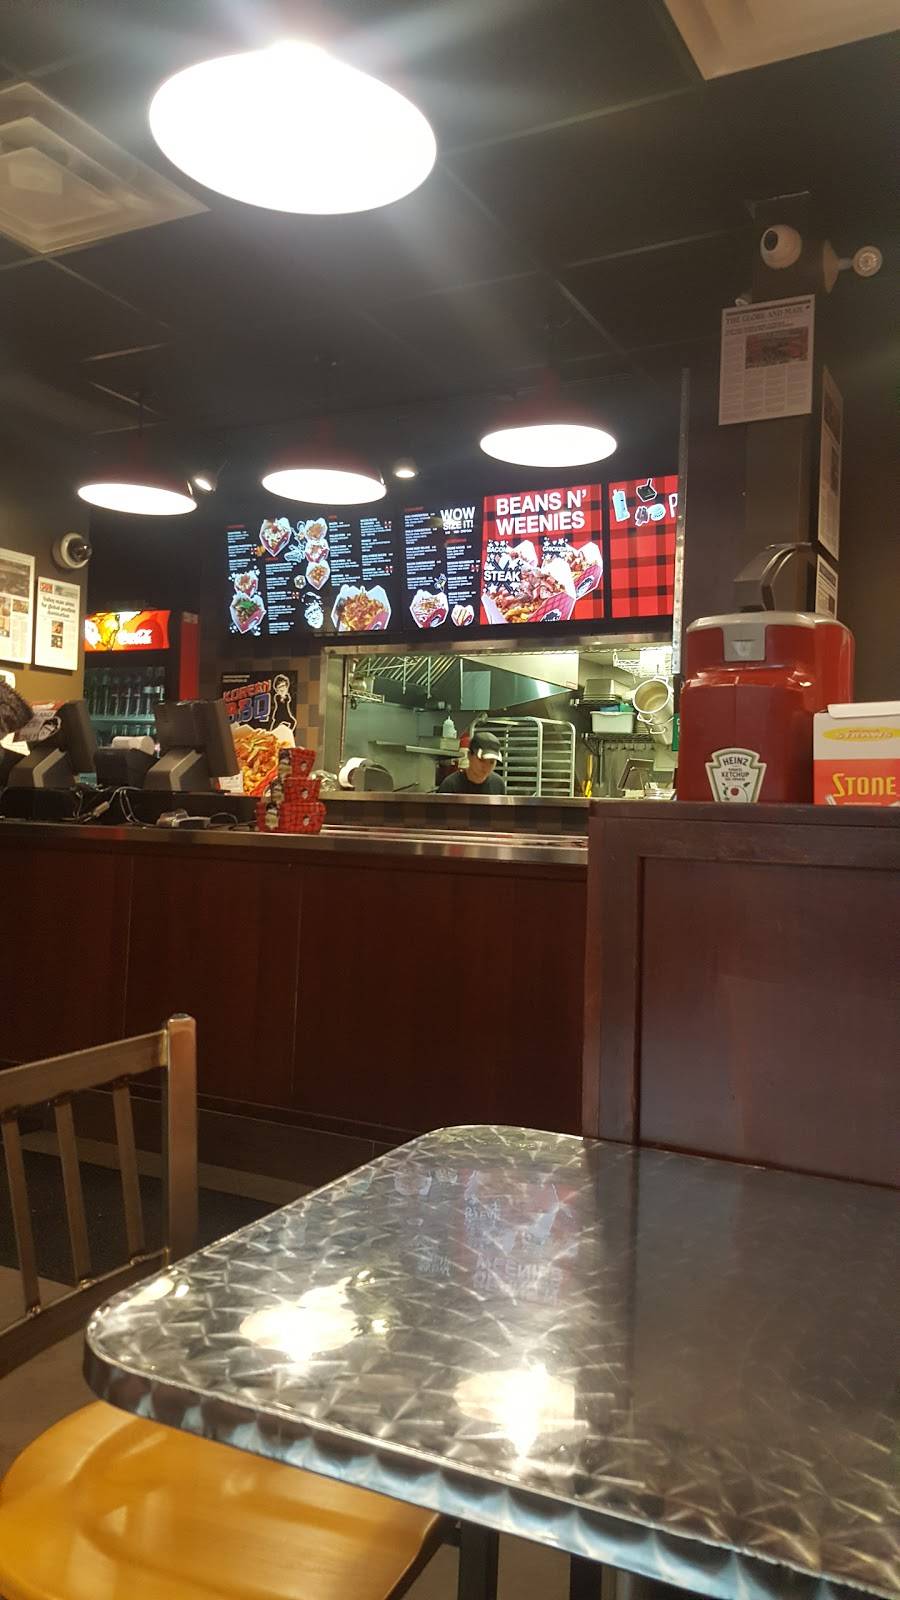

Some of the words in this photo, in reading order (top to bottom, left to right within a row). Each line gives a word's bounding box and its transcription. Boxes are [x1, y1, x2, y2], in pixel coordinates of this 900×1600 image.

[742, 312, 766, 322] GLOBE
[440, 506, 476, 520] WOW
[496, 492, 562, 516] BEANS
[442, 520, 463, 530] SIZE
[463, 519, 474, 529] IT!
[496, 511, 586, 536] WEENIES
[484, 570, 521, 582] STEAK
[223, 679, 272, 702] KOREAN
[224, 692, 271, 723] BBQ
[722, 756, 749, 766] HEINZ
[832, 772, 896, 798] STONE
